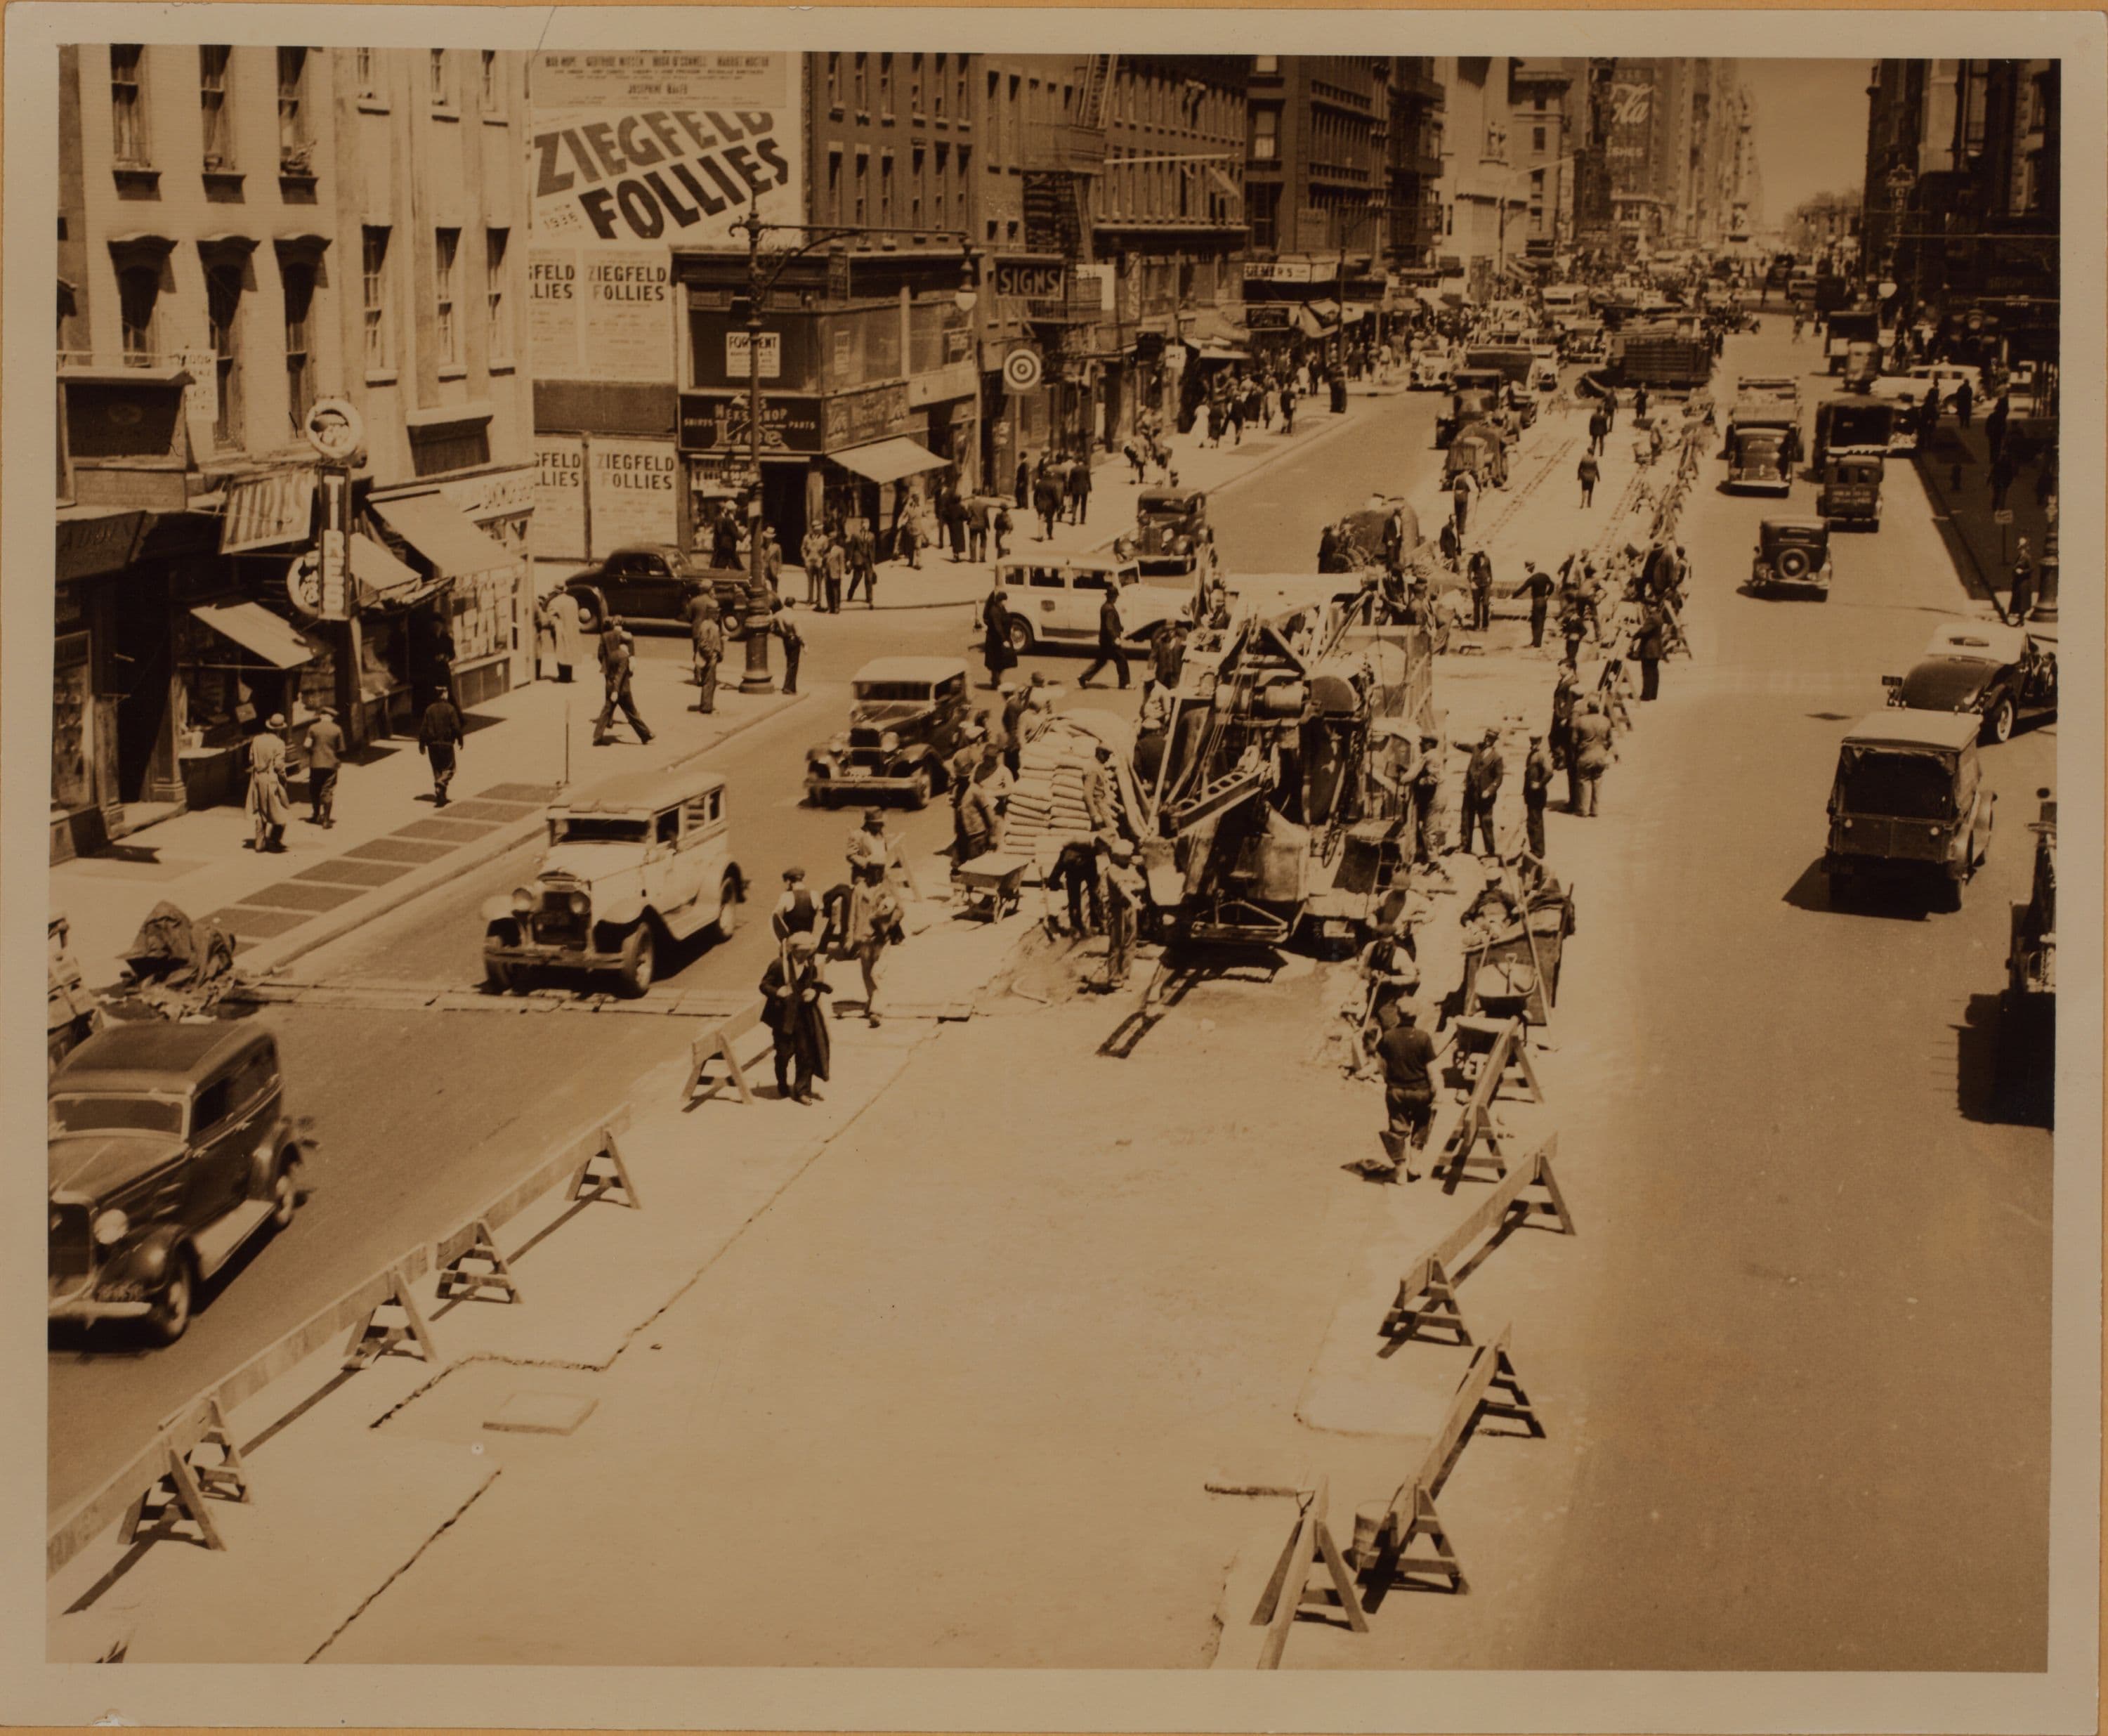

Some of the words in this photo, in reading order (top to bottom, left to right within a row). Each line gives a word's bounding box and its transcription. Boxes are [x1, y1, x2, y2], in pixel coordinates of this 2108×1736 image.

[535, 110, 773, 197] ZIEGFELD
[578, 138, 787, 240] FOLLIES
[530, 263, 575, 281] FELD
[589, 265, 669, 282] ZIEGFELD
[1000, 268, 1061, 294] SIGNS
[530, 282, 574, 300] LIES
[594, 283, 666, 301] FOLLIES
[759, 337, 777, 348] ENT
[597, 453, 676, 471] ZIEGFELD
[535, 470, 580, 487] LIES
[603, 474, 674, 490] FOLLIES
[323, 475, 345, 611] TIRES
